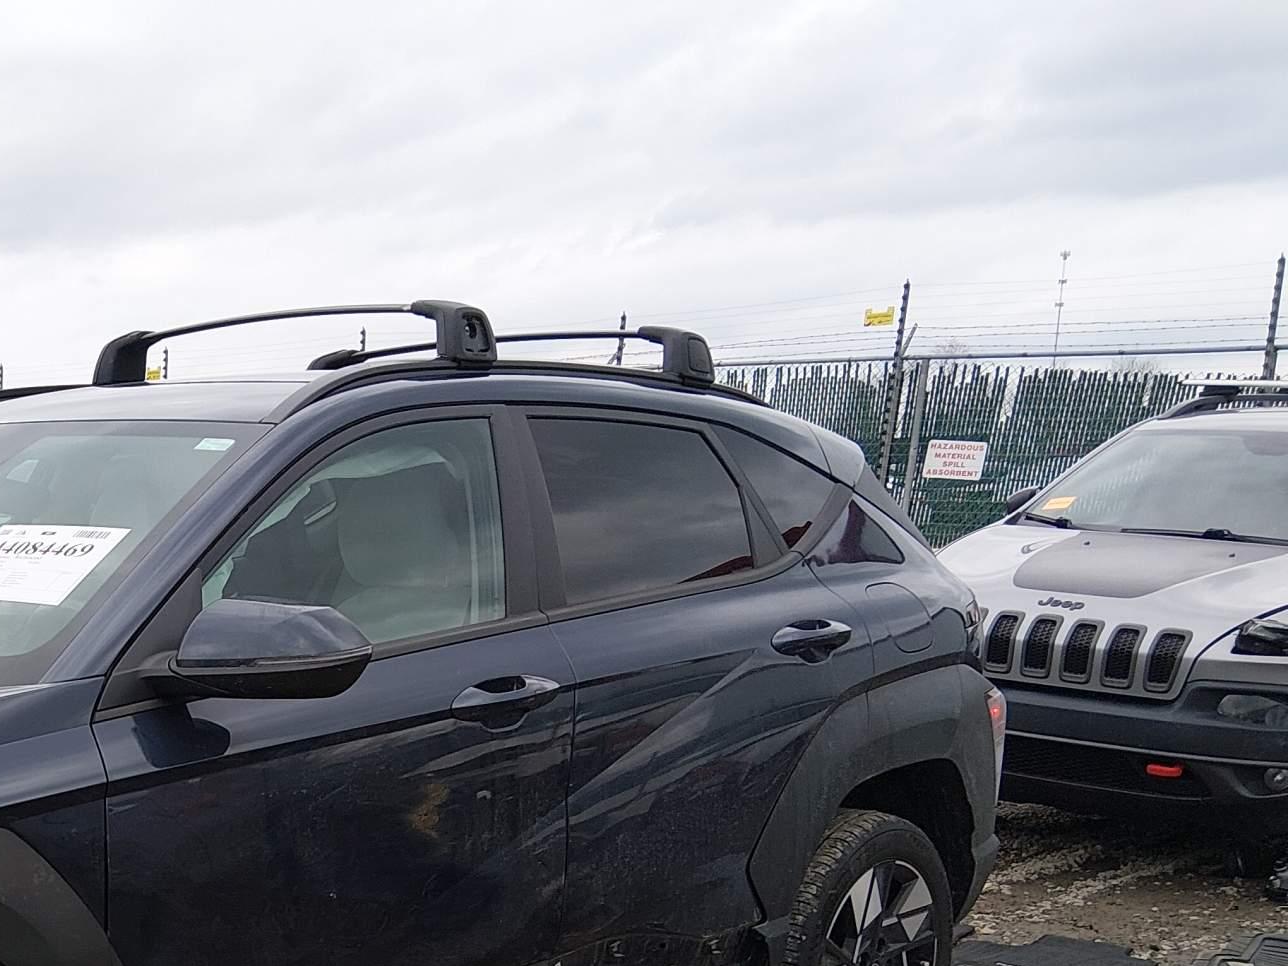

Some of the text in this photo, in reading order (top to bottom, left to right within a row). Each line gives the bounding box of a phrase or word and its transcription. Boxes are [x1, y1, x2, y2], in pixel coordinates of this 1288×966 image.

[930, 442, 985, 452] HAZARDOUS
[934, 452, 977, 460] MATERIAL
[925, 468, 979, 477] ABSORBENT
[1038, 597, 1085, 611] Jeep
